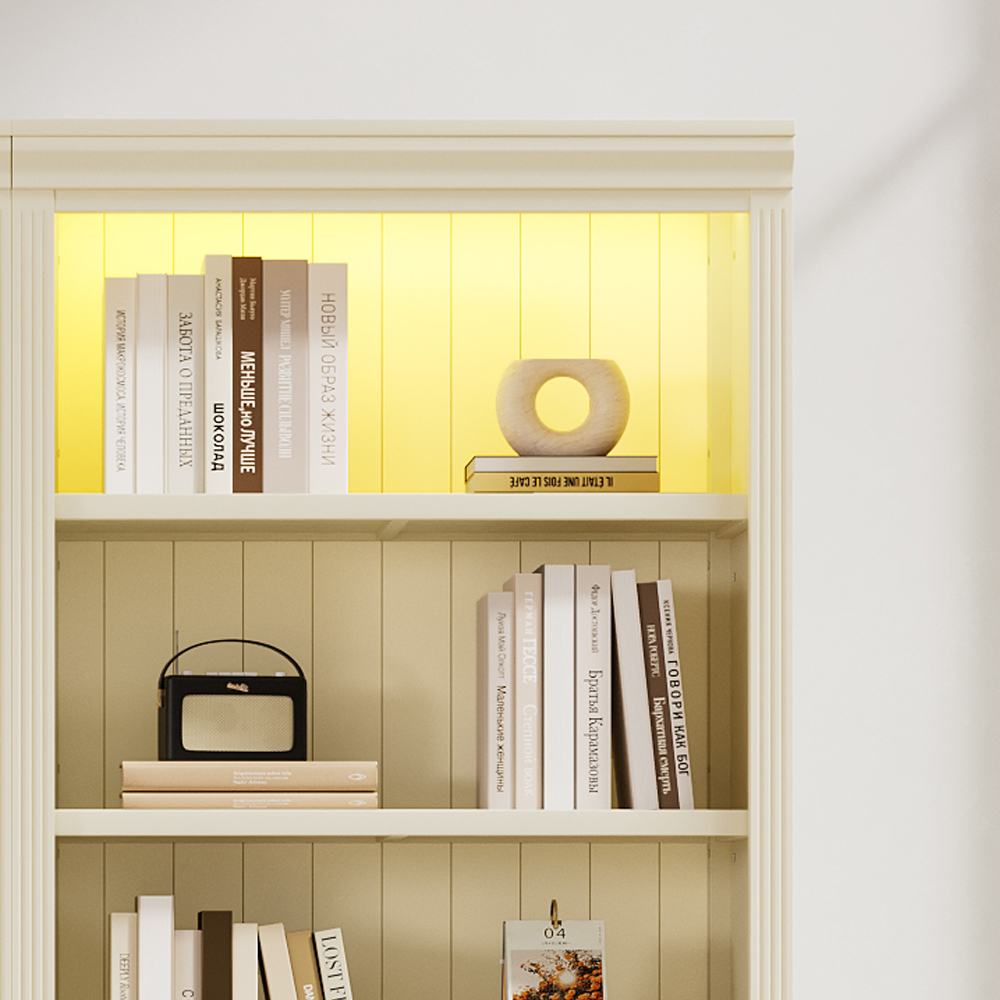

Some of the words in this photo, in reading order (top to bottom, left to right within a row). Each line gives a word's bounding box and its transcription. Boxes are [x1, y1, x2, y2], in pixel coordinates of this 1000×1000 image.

[179, 311, 193, 363] ЗАБОТА
[321, 292, 338, 349] НОВЫЙ
[321, 353, 336, 404] ОБРАЗ
[178, 382, 193, 468] ПРЕДАННЫХ
[212, 402, 225, 471] ШОКОЛАД
[321, 407, 336, 466] ЖИЗНИ
[531, 477, 542, 487] LE
[543, 477, 562, 487] FOIS
[564, 477, 580, 487] UNE
[606, 477, 613, 487] IL
[524, 591, 534, 636] ГЕРМАН
[523, 638, 537, 684] ГЕССЕ
[496, 685, 506, 742] Маленькие
[584, 669, 603, 714] Братья
[667, 659, 684, 720] ГОВОРИ
[523, 704, 537, 764] Степной
[651, 697, 667, 755] Бархатная
[674, 725, 687, 749] КАК
[495, 743, 505, 793] женщины
[584, 717, 603, 793] Карамазовы
[656, 756, 672, 796] смерть
[676, 754, 690, 777] БОГ
[544, 928, 566, 939] 04
[321, 935, 344, 982] LOST
